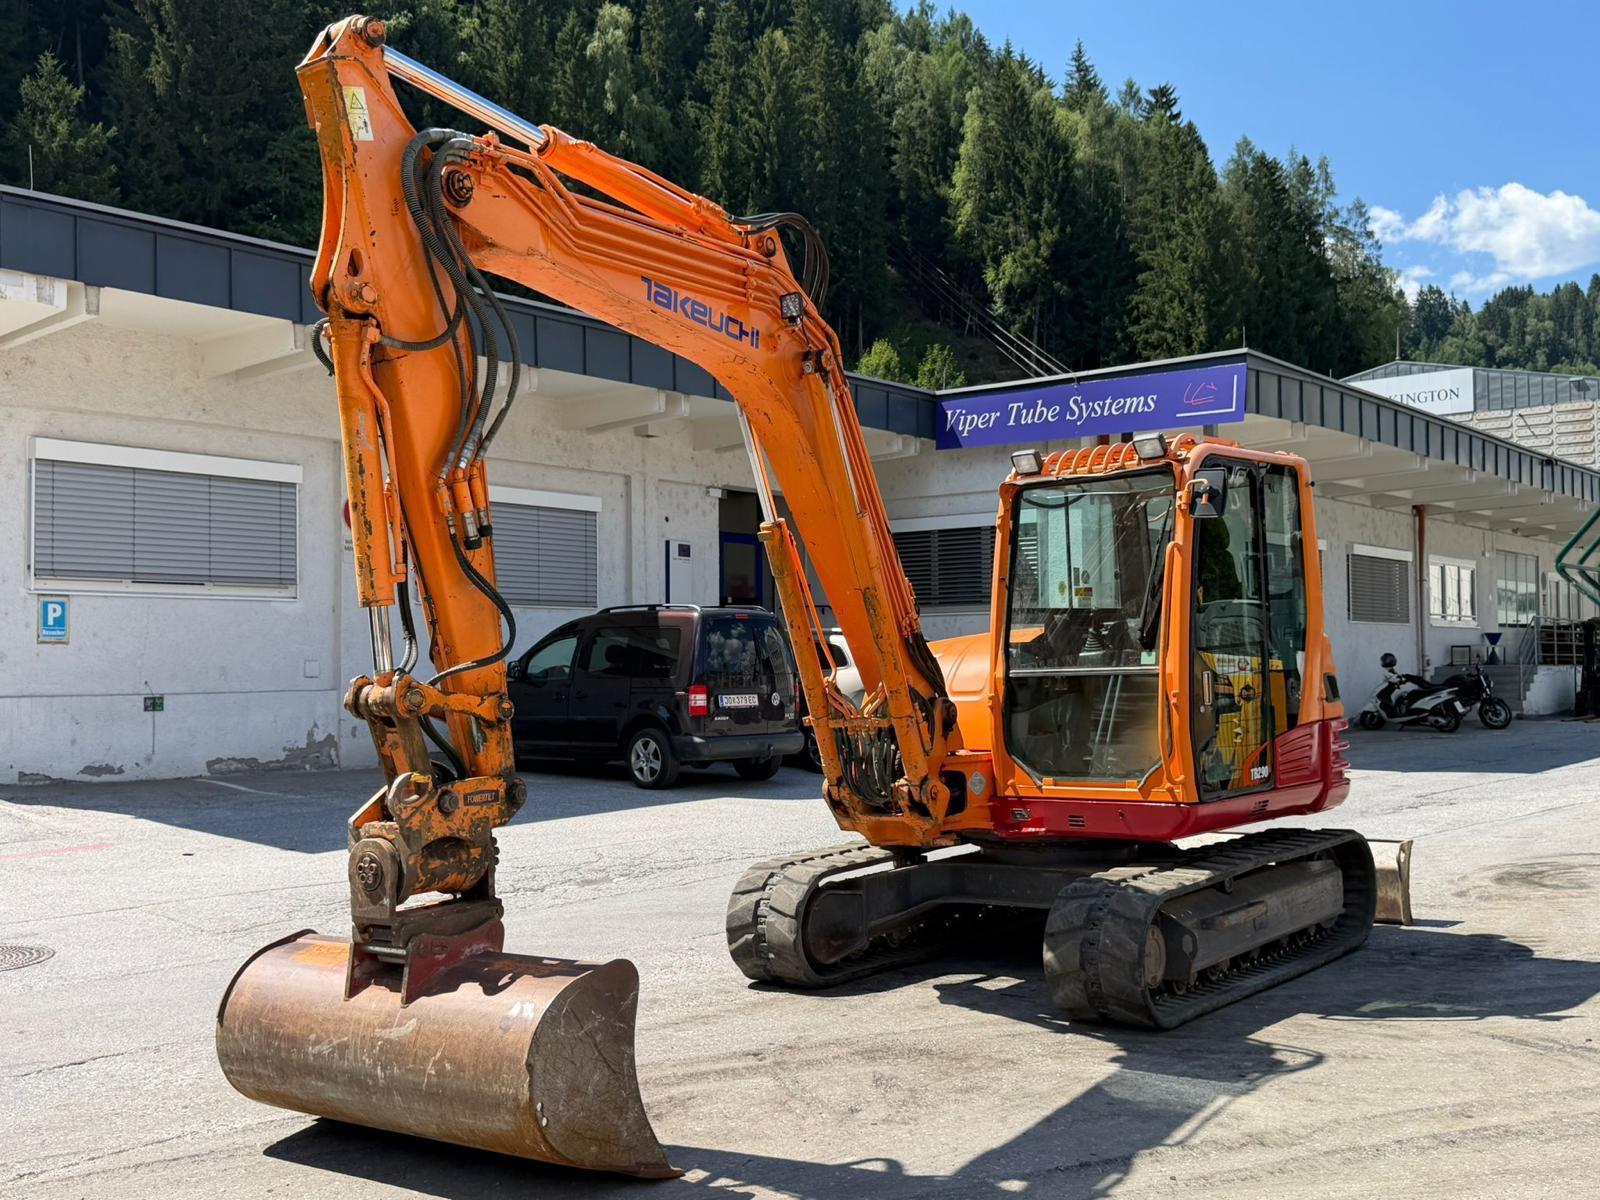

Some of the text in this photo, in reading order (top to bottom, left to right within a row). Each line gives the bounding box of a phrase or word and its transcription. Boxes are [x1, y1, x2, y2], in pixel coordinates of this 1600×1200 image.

[945, 393, 1157, 436] Viper Tube Systems
[47, 603, 62, 625] P
[1250, 765, 1269, 780] TB290
